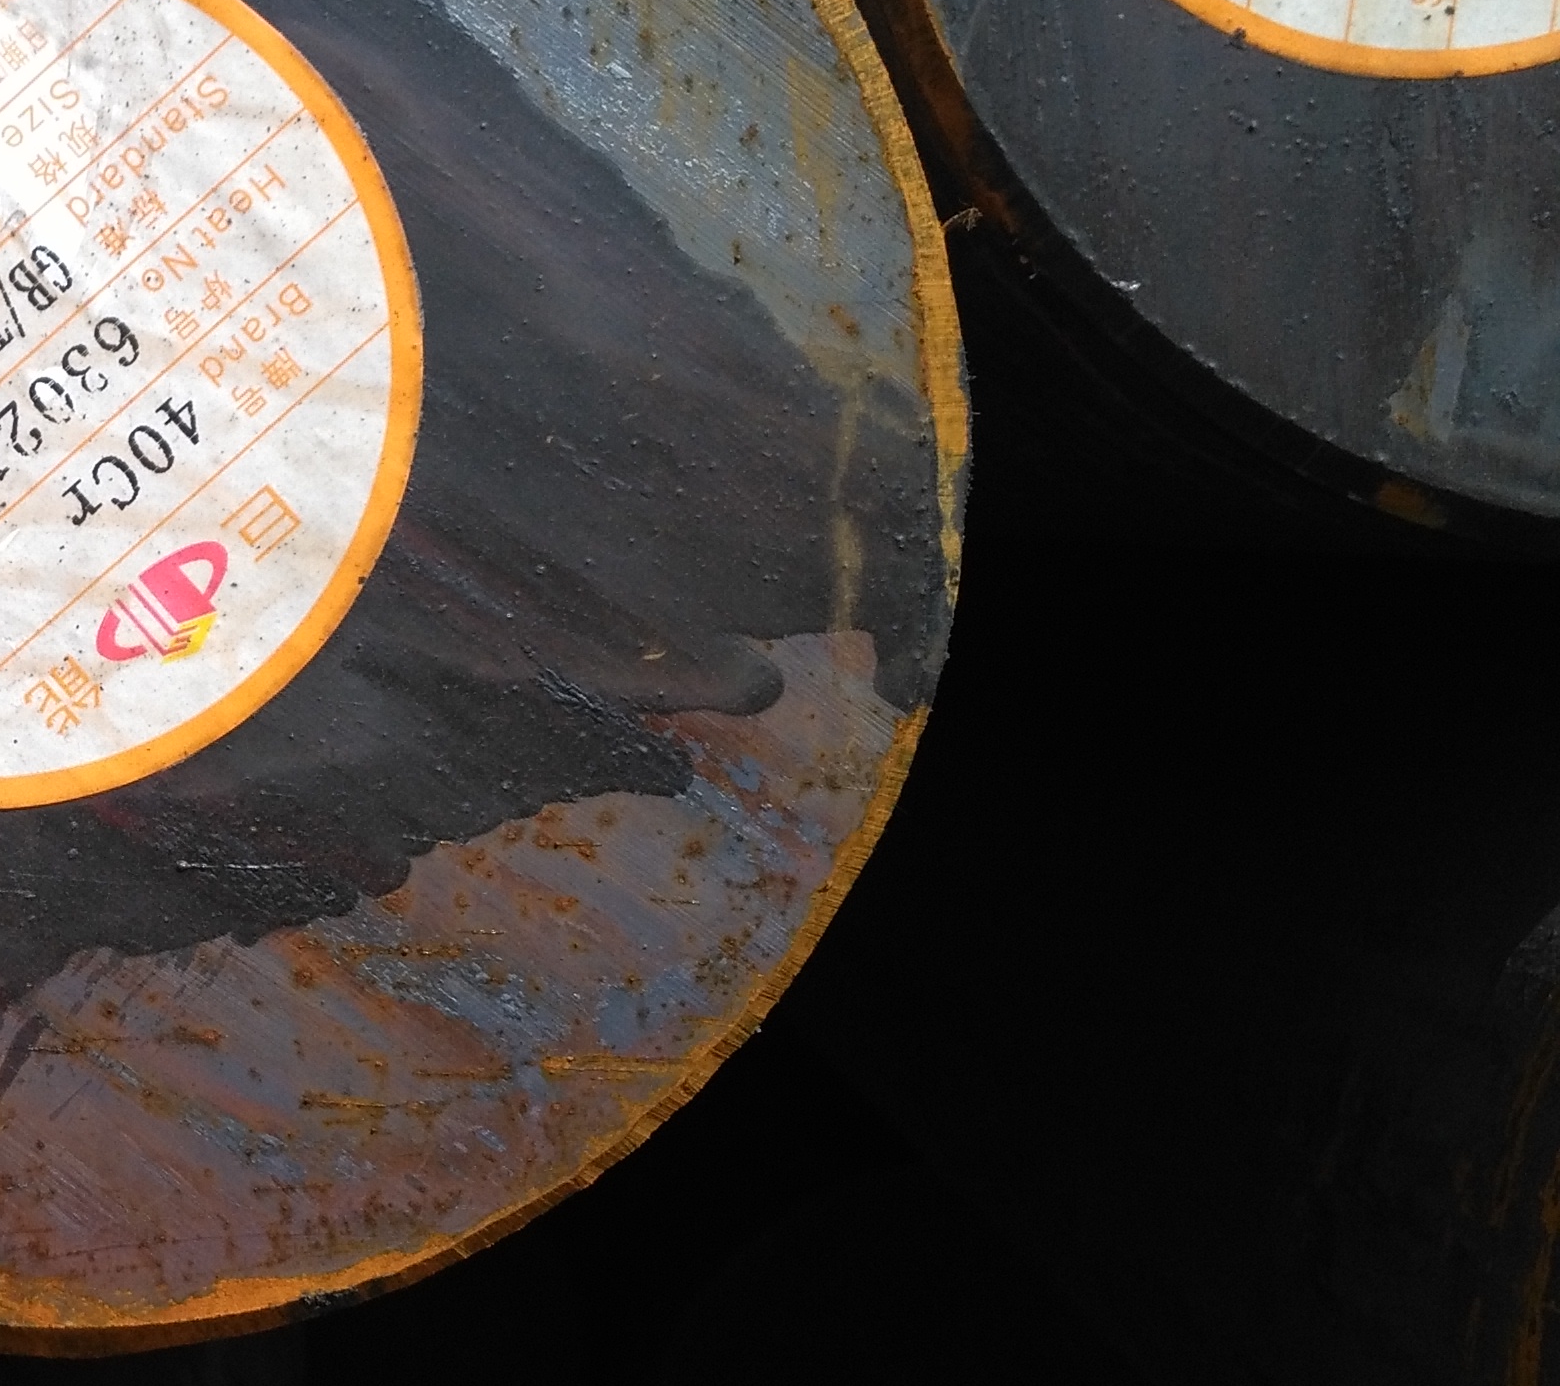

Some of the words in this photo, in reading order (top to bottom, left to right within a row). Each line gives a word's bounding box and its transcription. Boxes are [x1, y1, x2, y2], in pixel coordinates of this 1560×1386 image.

[0, 78, 80, 150] Size
[27, 115, 99, 187] 规格
[66, 74, 229, 228] Standard
[95, 187, 168, 256] 标准
[193, 163, 287, 250] Heat
[141, 243, 197, 293] No
[165, 270, 232, 341] 炉号
[198, 282, 313, 387] Brand
[231, 349, 302, 417] 牌号
[62, 397, 200, 527] 40Cr
